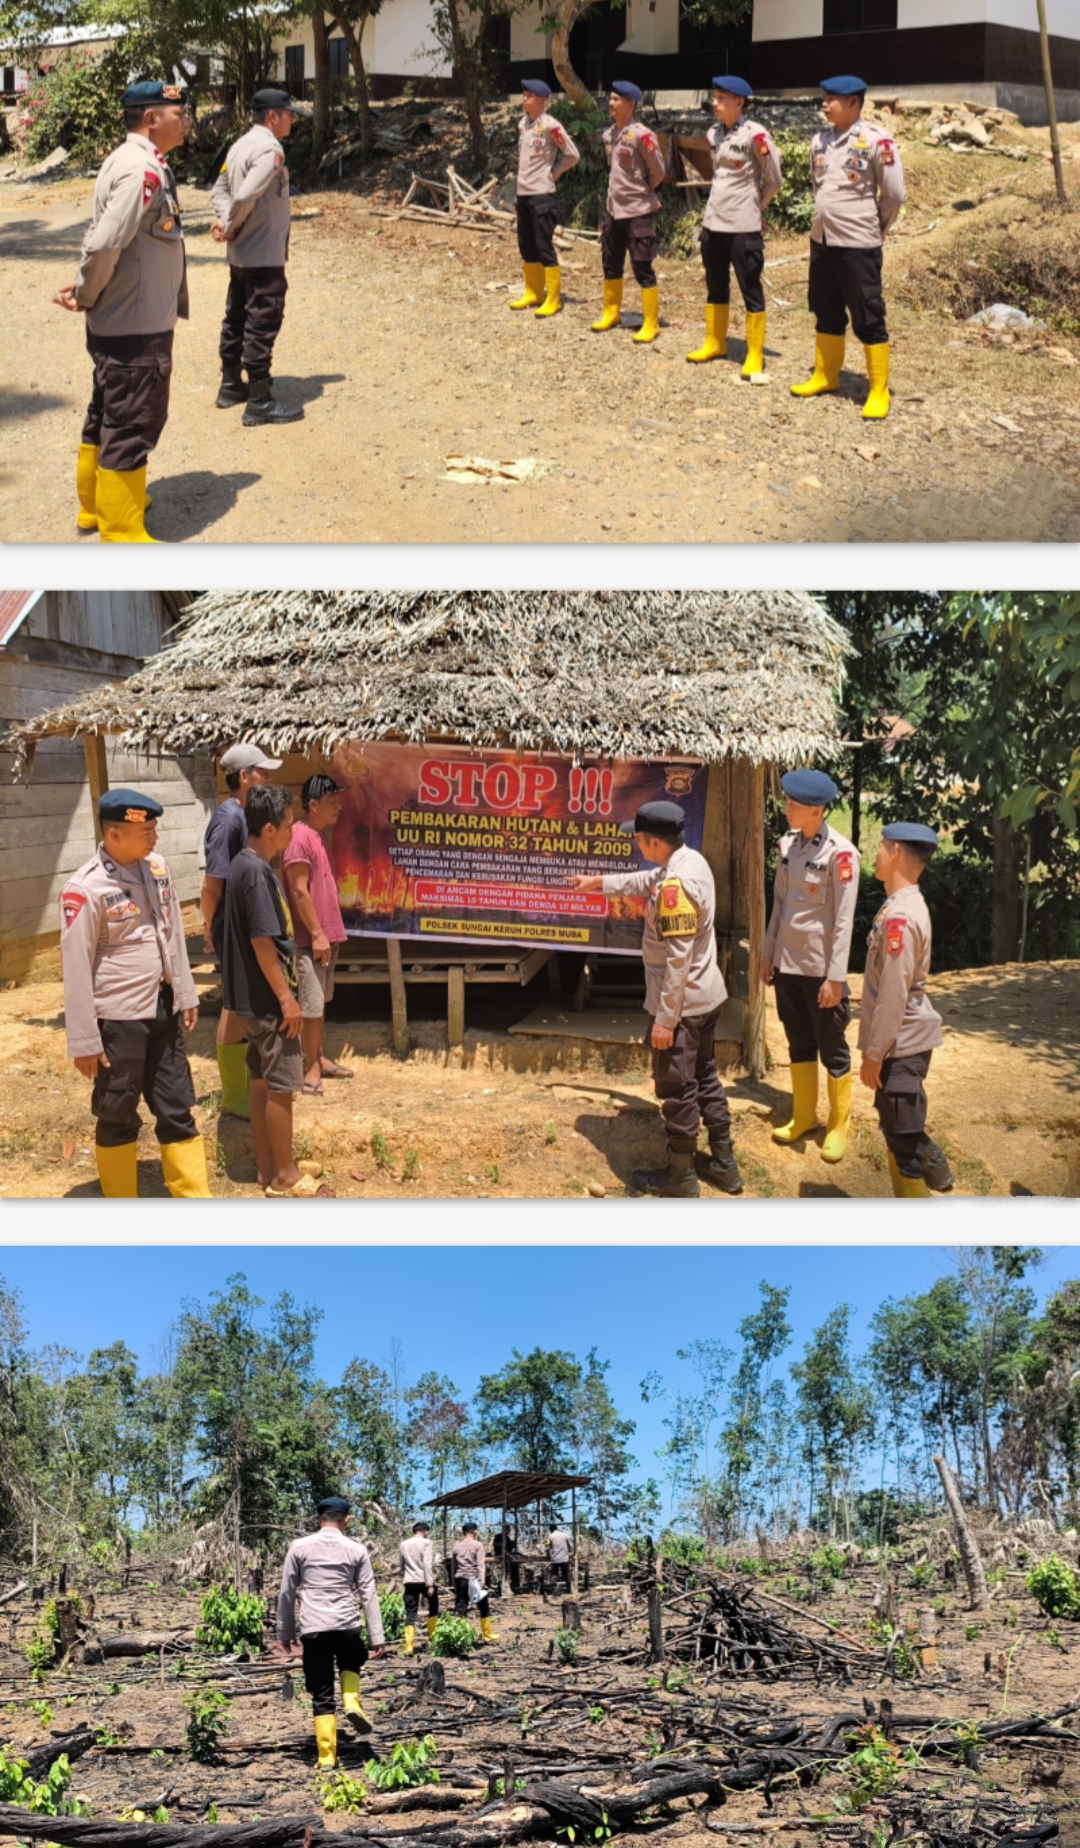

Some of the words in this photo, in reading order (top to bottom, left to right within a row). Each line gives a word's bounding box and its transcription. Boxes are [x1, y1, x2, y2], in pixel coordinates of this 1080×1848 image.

[418, 760, 557, 809] STOP
[568, 767, 614, 815] !!!
[390, 810, 502, 829] PEMBAKARAN
[506, 816, 562, 834] HUTAN
[566, 821, 579, 836] &
[397, 828, 420, 843] UU
[424, 830, 440, 844] RI
[445, 832, 505, 848] NOMOR
[509, 836, 527, 850] 32
[533, 837, 588, 854] TAHUN
[593, 841, 632, 856] 2009
[389, 847, 414, 856] SETIAP
[415, 849, 440, 858] ORANG
[442, 850, 461, 859] YANG
[463, 851, 493, 861] DENGAN
[495, 853, 527, 864] SENGAJA
[529, 856, 566, 866] MEMBUKA
[567, 858, 586, 867] ATAU
[588, 860, 638, 870] MENGELOLAH
[394, 858, 418, 866] LAHAN
[420, 859, 449, 868] DENGAN
[450, 860, 469, 869] CARA
[471, 862, 521, 873] PEMBAKARAN
[523, 864, 542, 874] YANG
[545, 866, 585, 876] BERAKIBAT
[405, 868, 454, 878] PENCEMARAN
[455, 871, 470, 879] DAN
[472, 872, 515, 882] KERUSAKAN
[518, 875, 544, 885] FUNGSI
[421, 893, 465, 903] MAKSIMAL
[467, 896, 477, 904] 10
[480, 897, 507, 906] TAHUN
[509, 900, 526, 908] DAN
[529, 901, 557, 910] DENDA
[559, 903, 568, 911] 10
[571, 904, 602, 912] MILYAR
[447, 887, 476, 895] ANCAM
[479, 888, 513, 897] DENGAN
[515, 891, 546, 900] PIDANA
[548, 893, 587, 903] PENJARA
[426, 921, 458, 930] POLSEK
[461, 922, 492, 932] SUNGAI
[494, 924, 522, 934] KERUH
[524, 926, 556, 936] POLRES
[559, 928, 583, 938] MUBA
